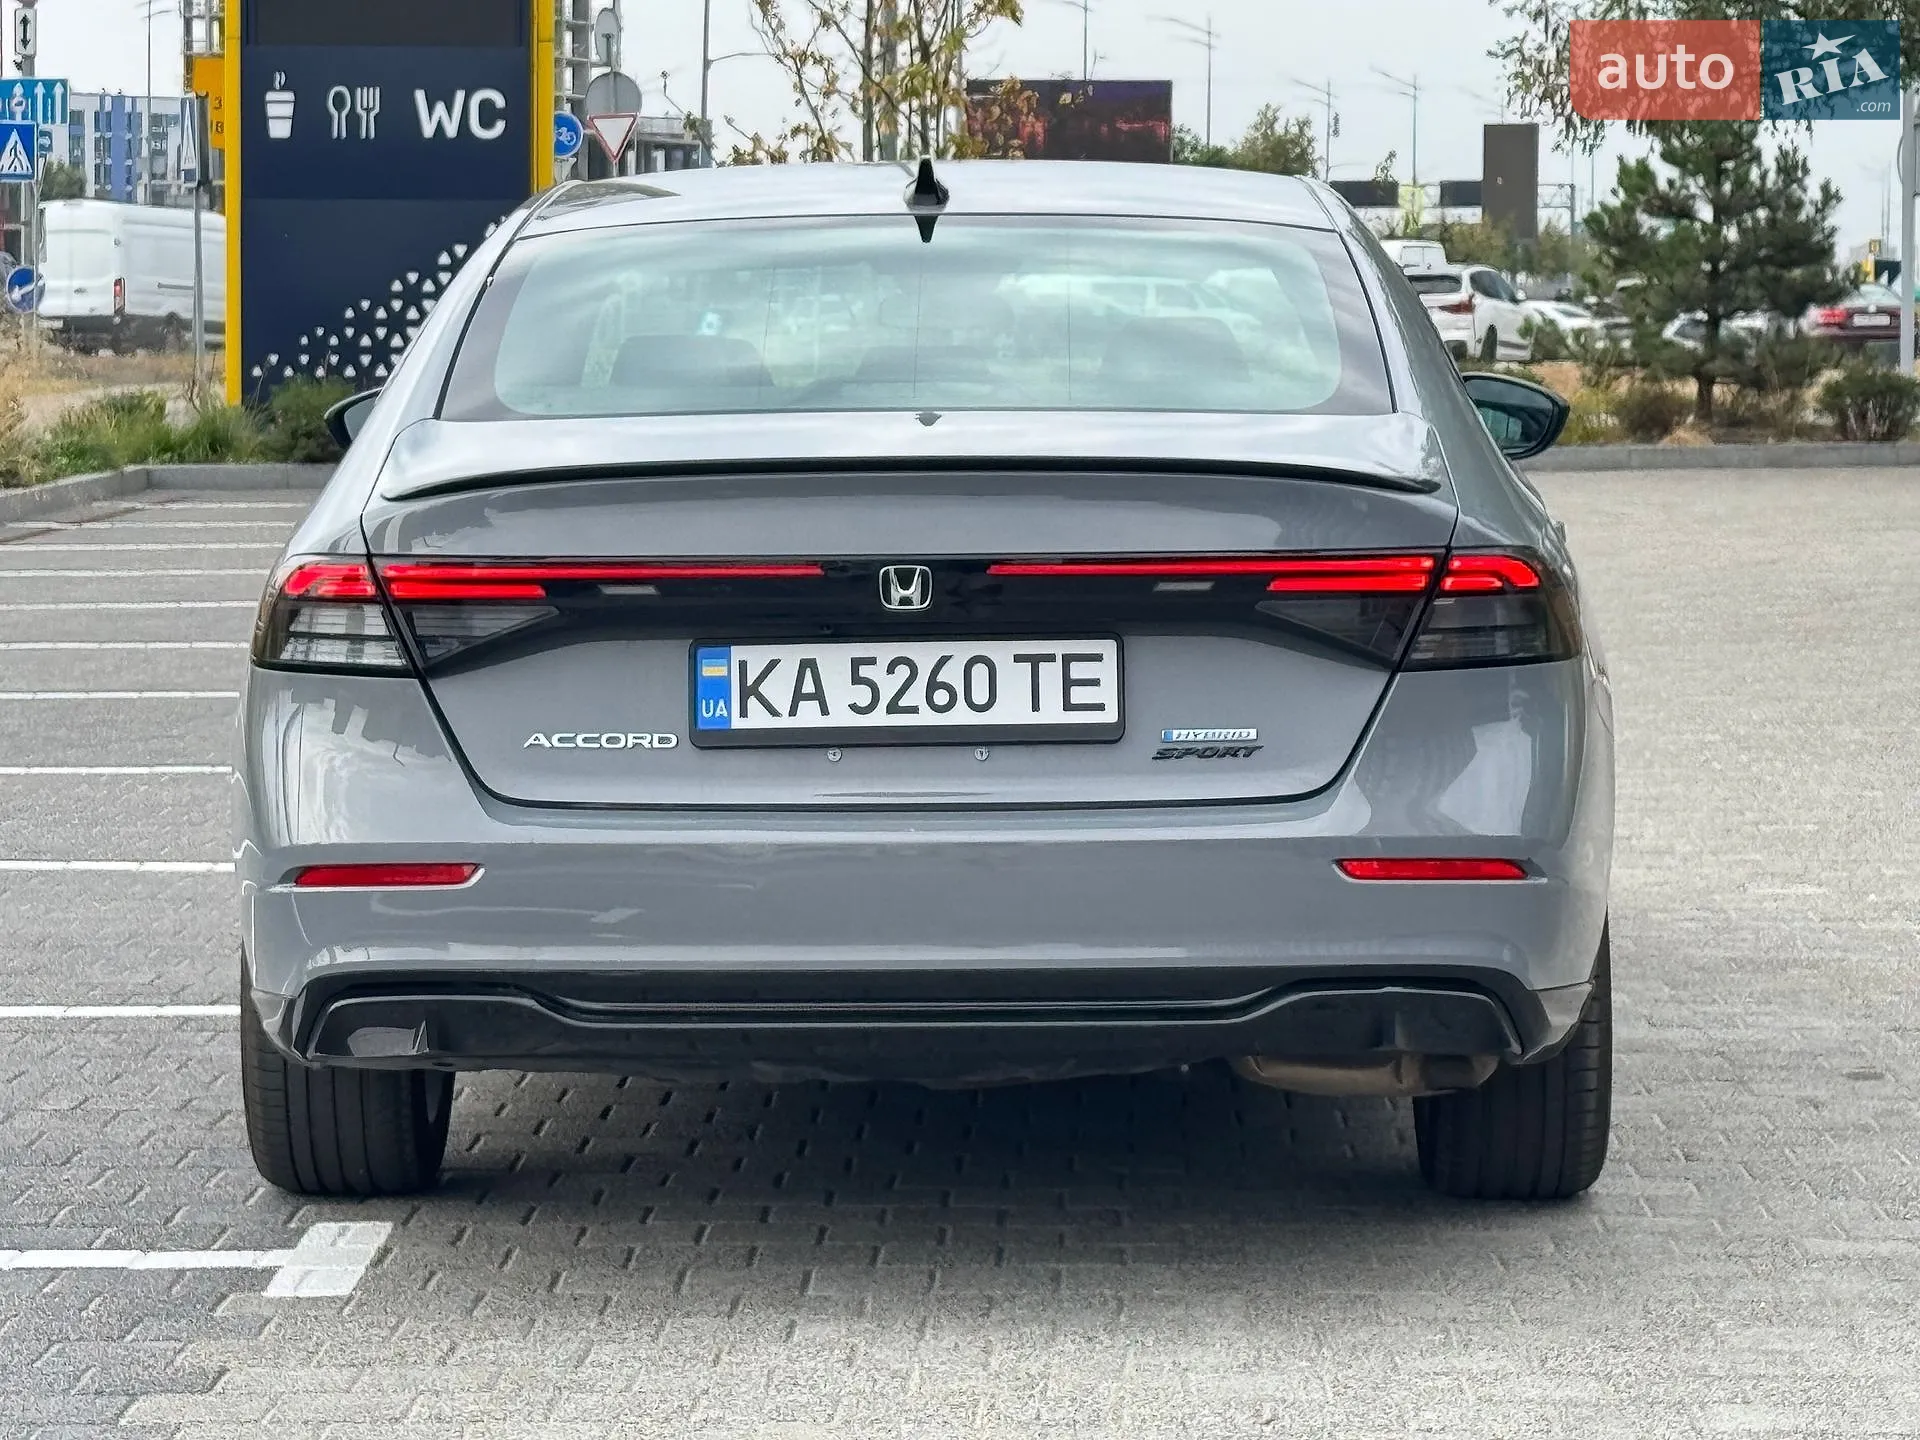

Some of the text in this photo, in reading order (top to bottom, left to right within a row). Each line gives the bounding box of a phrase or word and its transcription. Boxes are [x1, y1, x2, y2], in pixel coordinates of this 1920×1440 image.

[414, 88, 506, 139] WC
[738, 653, 1106, 718] KA 5260 TE
[702, 698, 728, 718] UA
[523, 732, 679, 750] ACCORD
[1174, 730, 1252, 740] HYBRID
[1151, 745, 1264, 760] SPORT
